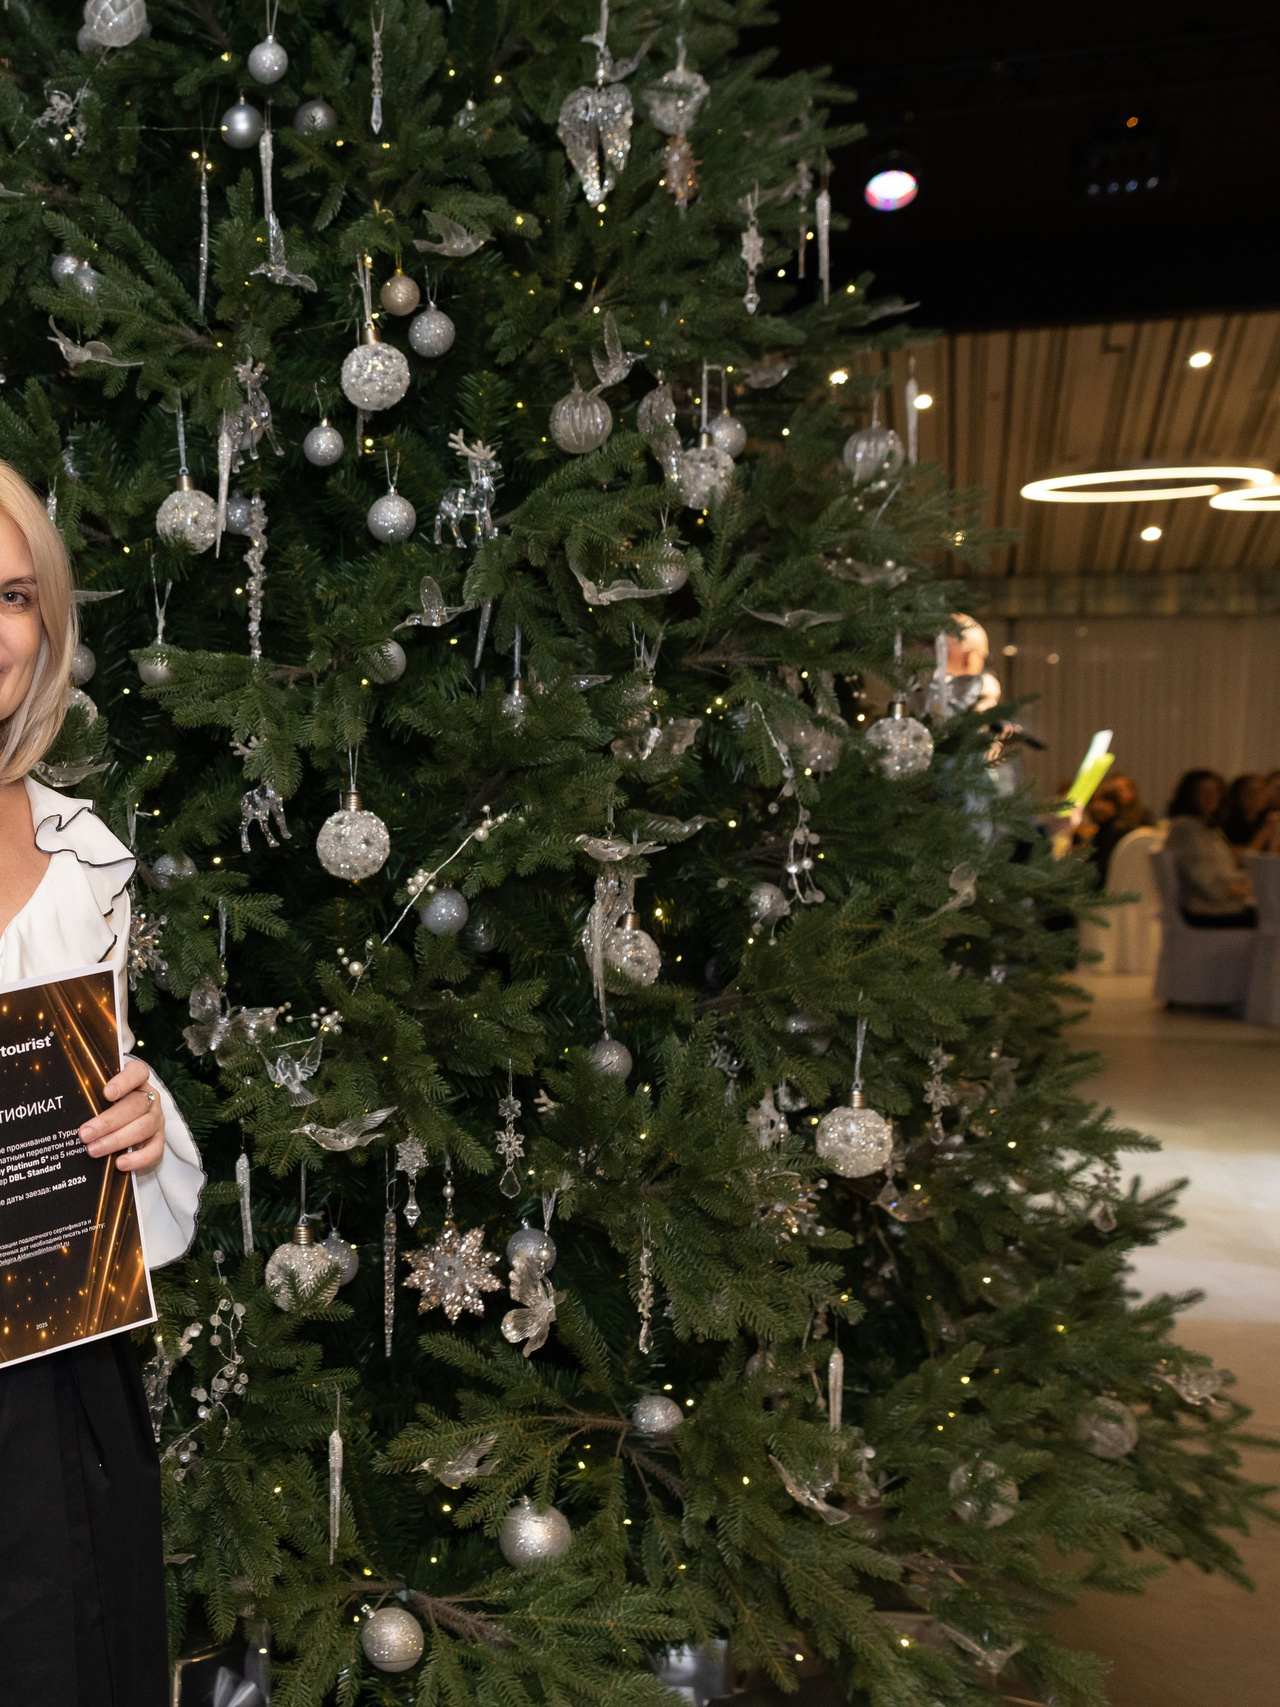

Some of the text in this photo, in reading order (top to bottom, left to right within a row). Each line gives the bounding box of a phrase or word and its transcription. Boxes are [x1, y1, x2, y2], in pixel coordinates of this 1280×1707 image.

[6, 1135, 51, 1153] проживание
[58, 1128, 80, 1140] Турци
[26, 1142, 65, 1158] перелетом
[65, 1139, 74, 1147] на
[6, 1158, 40, 1174] Platinum
[50, 1154, 59, 1162] на
[60, 1150, 65, 1159] 5
[66, 1145, 87, 1157] ночей
[27, 1161, 61, 1178] Standard
[6, 1194, 24, 1205] даты
[25, 1186, 51, 1200] заезда:
[52, 1180, 67, 1192] май
[67, 1175, 87, 1187] 2026
[18, 1230, 53, 1245] подарочного
[53, 1220, 87, 1235] сертификата
[19, 1245, 29, 1253] дат
[29, 1235, 62, 1249] необходимо
[62, 1229, 81, 1240] писать
